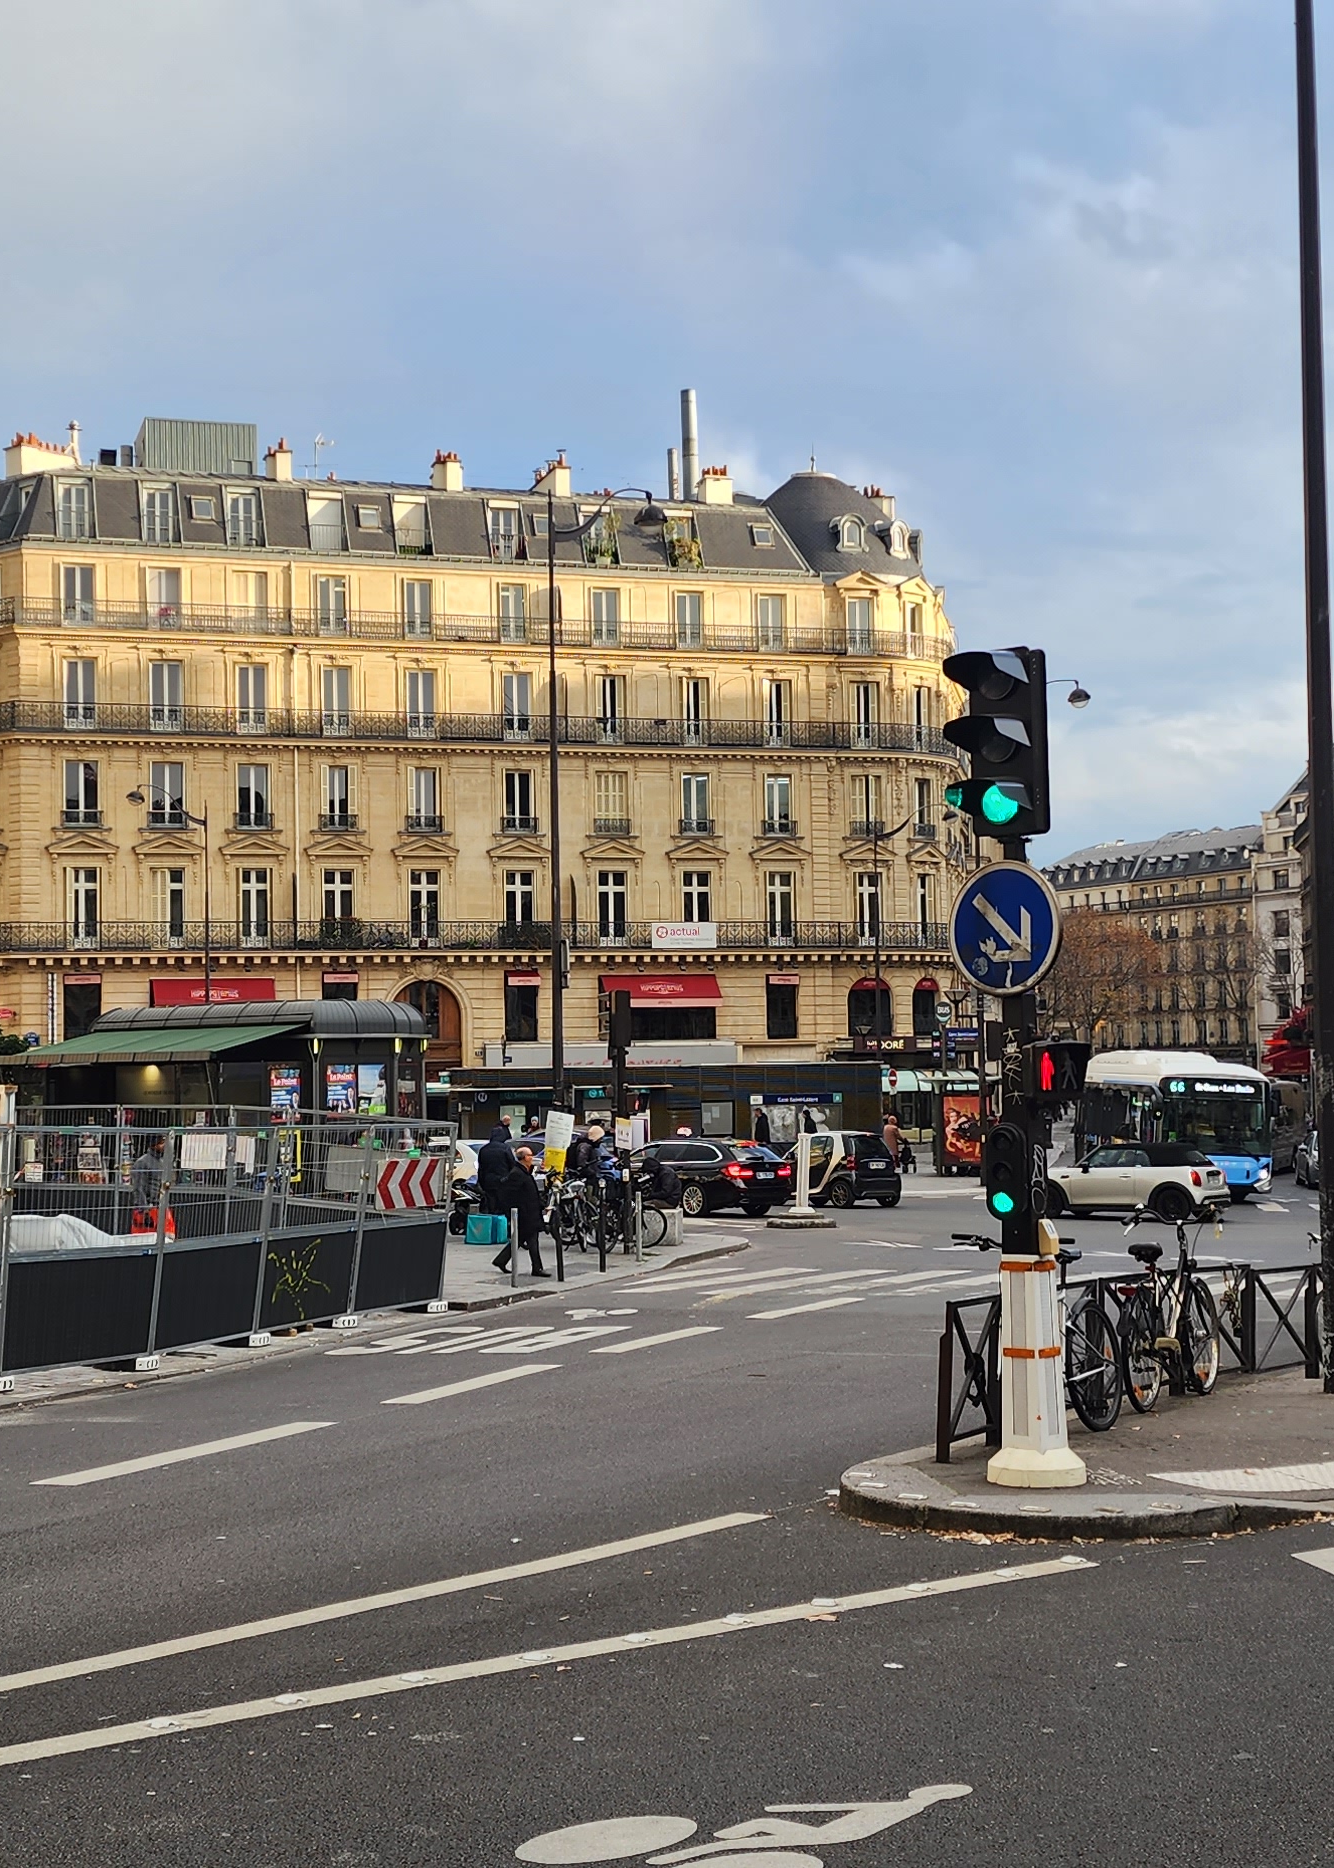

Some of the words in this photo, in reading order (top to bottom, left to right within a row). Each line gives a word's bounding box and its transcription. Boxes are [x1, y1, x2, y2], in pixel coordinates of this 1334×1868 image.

[669, 926, 700, 936] actual
[1169, 1081, 1185, 1093] 66
[323, 1326, 633, 1356] BUS
